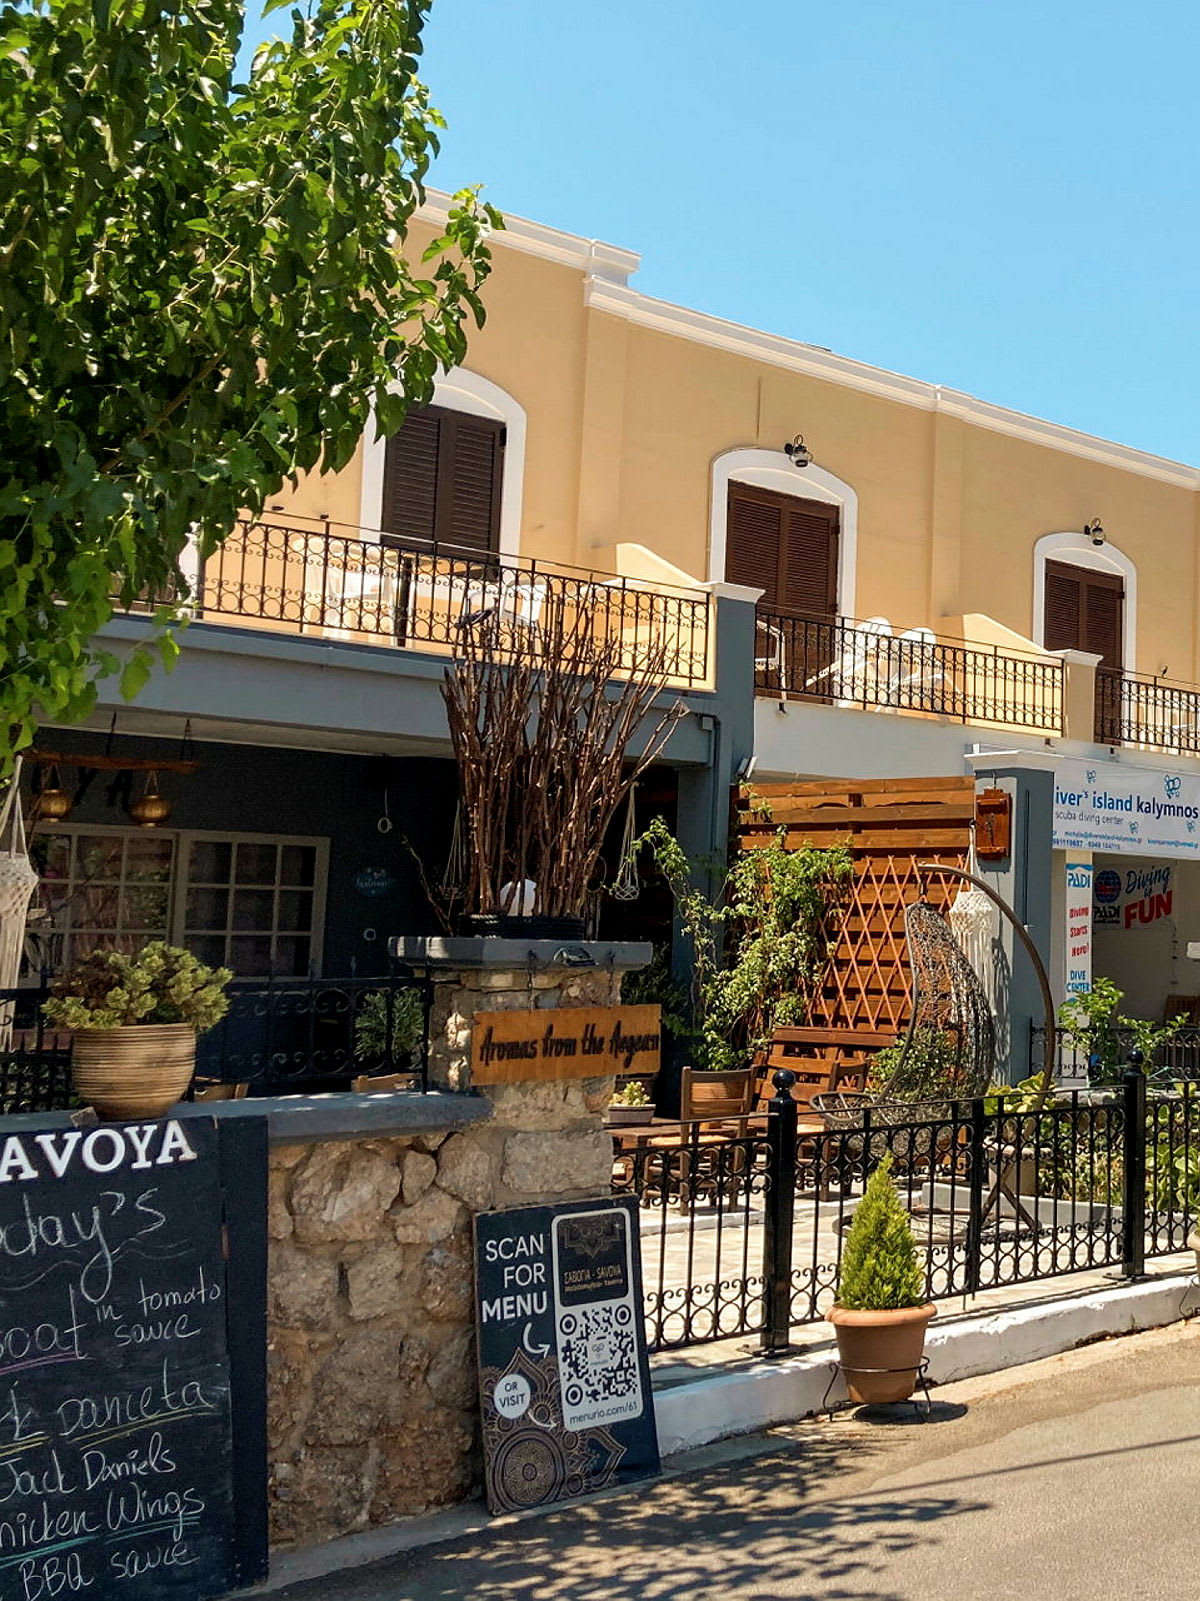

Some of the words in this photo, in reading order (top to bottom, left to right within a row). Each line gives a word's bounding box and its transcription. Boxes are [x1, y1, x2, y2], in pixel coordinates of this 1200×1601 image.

[1055, 810, 1076, 820] scuba
[1078, 811, 1100, 826] diving
[1102, 815, 1125, 825] center
[1092, 791, 1133, 812] island
[1136, 795, 1199, 820] kalymnos
[1067, 873, 1090, 888] PADI
[1125, 866, 1170, 895] Diving
[1069, 906, 1089, 919] Diving
[1093, 905, 1120, 919] PADI
[1124, 890, 1173, 929] FUN
[1070, 925, 1088, 938] Starts
[1067, 983, 1090, 993] CENTER
[1070, 970, 1086, 980] DIVE
[479, 1025, 537, 1066] Aromas
[541, 1023, 578, 1058] from
[581, 1023, 605, 1055] the
[609, 1020, 660, 1068] Aegean
[0, 1187, 166, 1302] day's
[485, 1233, 544, 1262] SCAN
[503, 1262, 546, 1289] FOR
[94, 1302, 123, 1322] in
[138, 1266, 221, 1317] tomato
[481, 1290, 548, 1323] MENU
[114, 1314, 201, 1347] sauce
[499, 1393, 525, 1408] VISIT
[504, 1381, 519, 1393] OR
[0, 1449, 77, 1501] Jack
[81, 1431, 176, 1491] Daniels
[107, 1482, 205, 1541] Wings
[19, 1552, 94, 1601] BBQ
[111, 1541, 201, 1578] sauce
